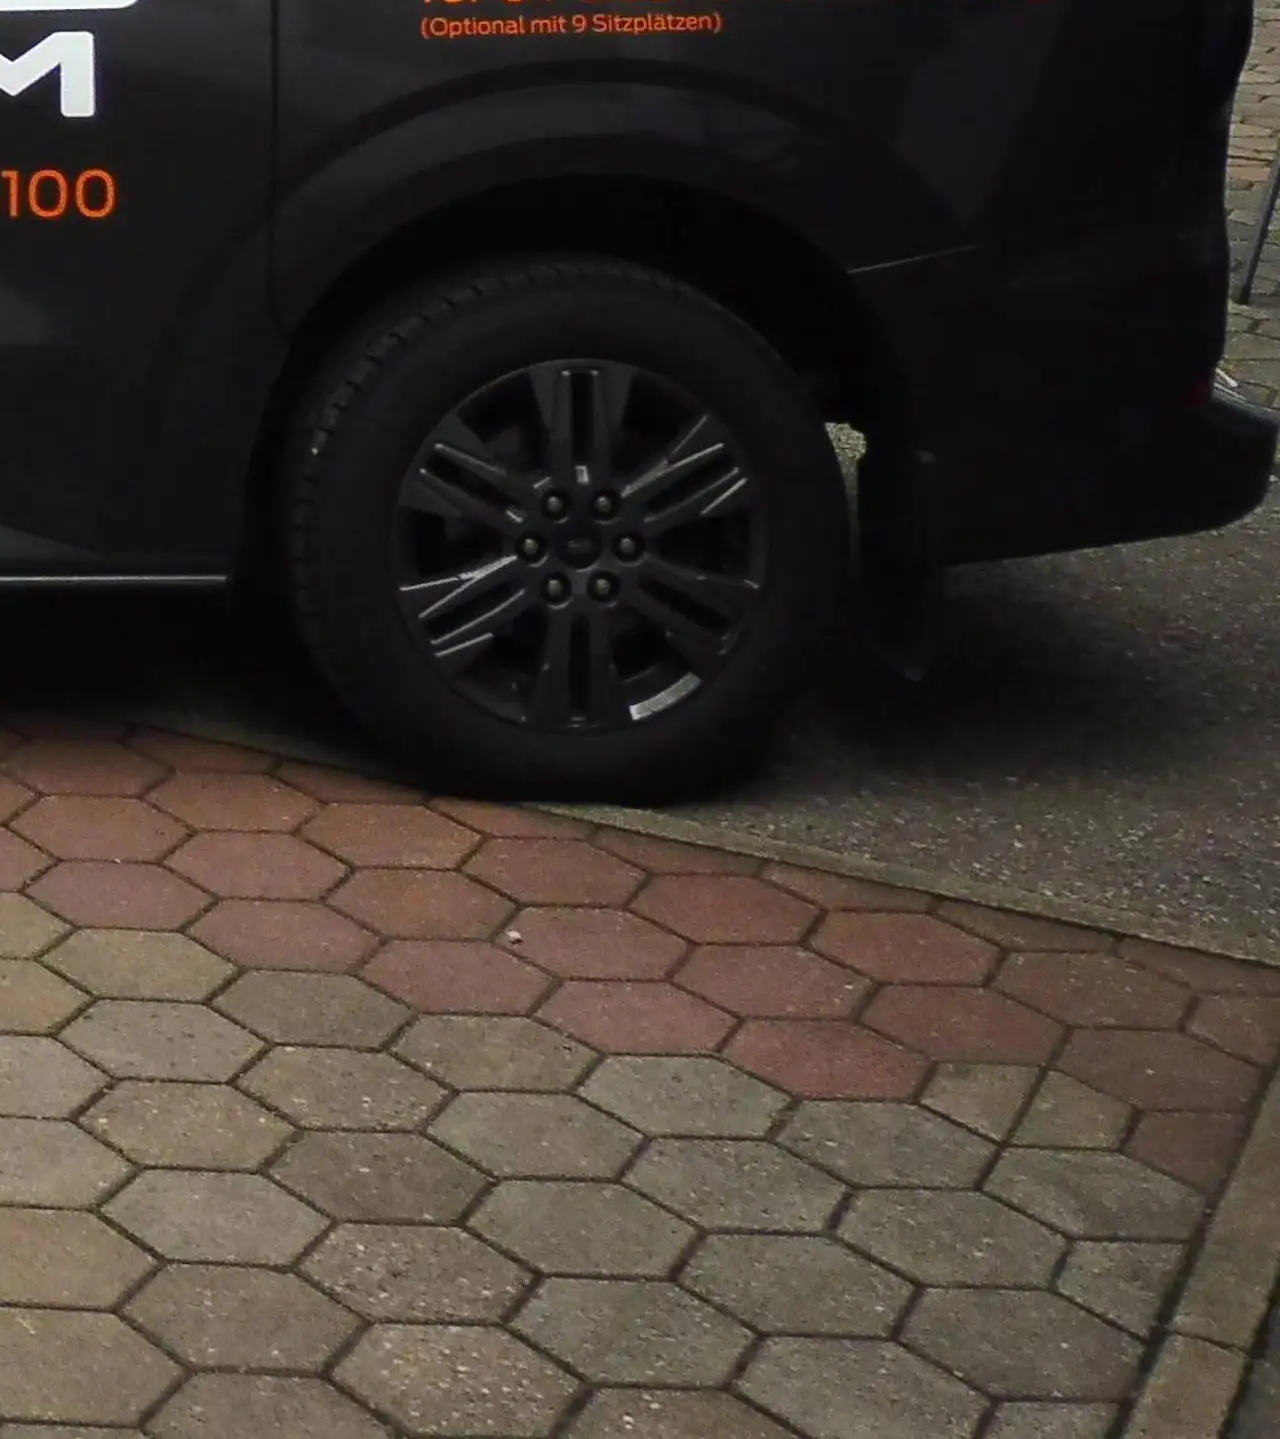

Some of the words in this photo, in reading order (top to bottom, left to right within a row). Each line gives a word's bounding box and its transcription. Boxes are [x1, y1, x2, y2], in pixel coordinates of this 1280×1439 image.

[420, 14, 526, 39] (Optional
[530, 14, 568, 35] mit
[571, 14, 588, 34] 9
[591, 11, 723, 35] Sitzplätzen)
